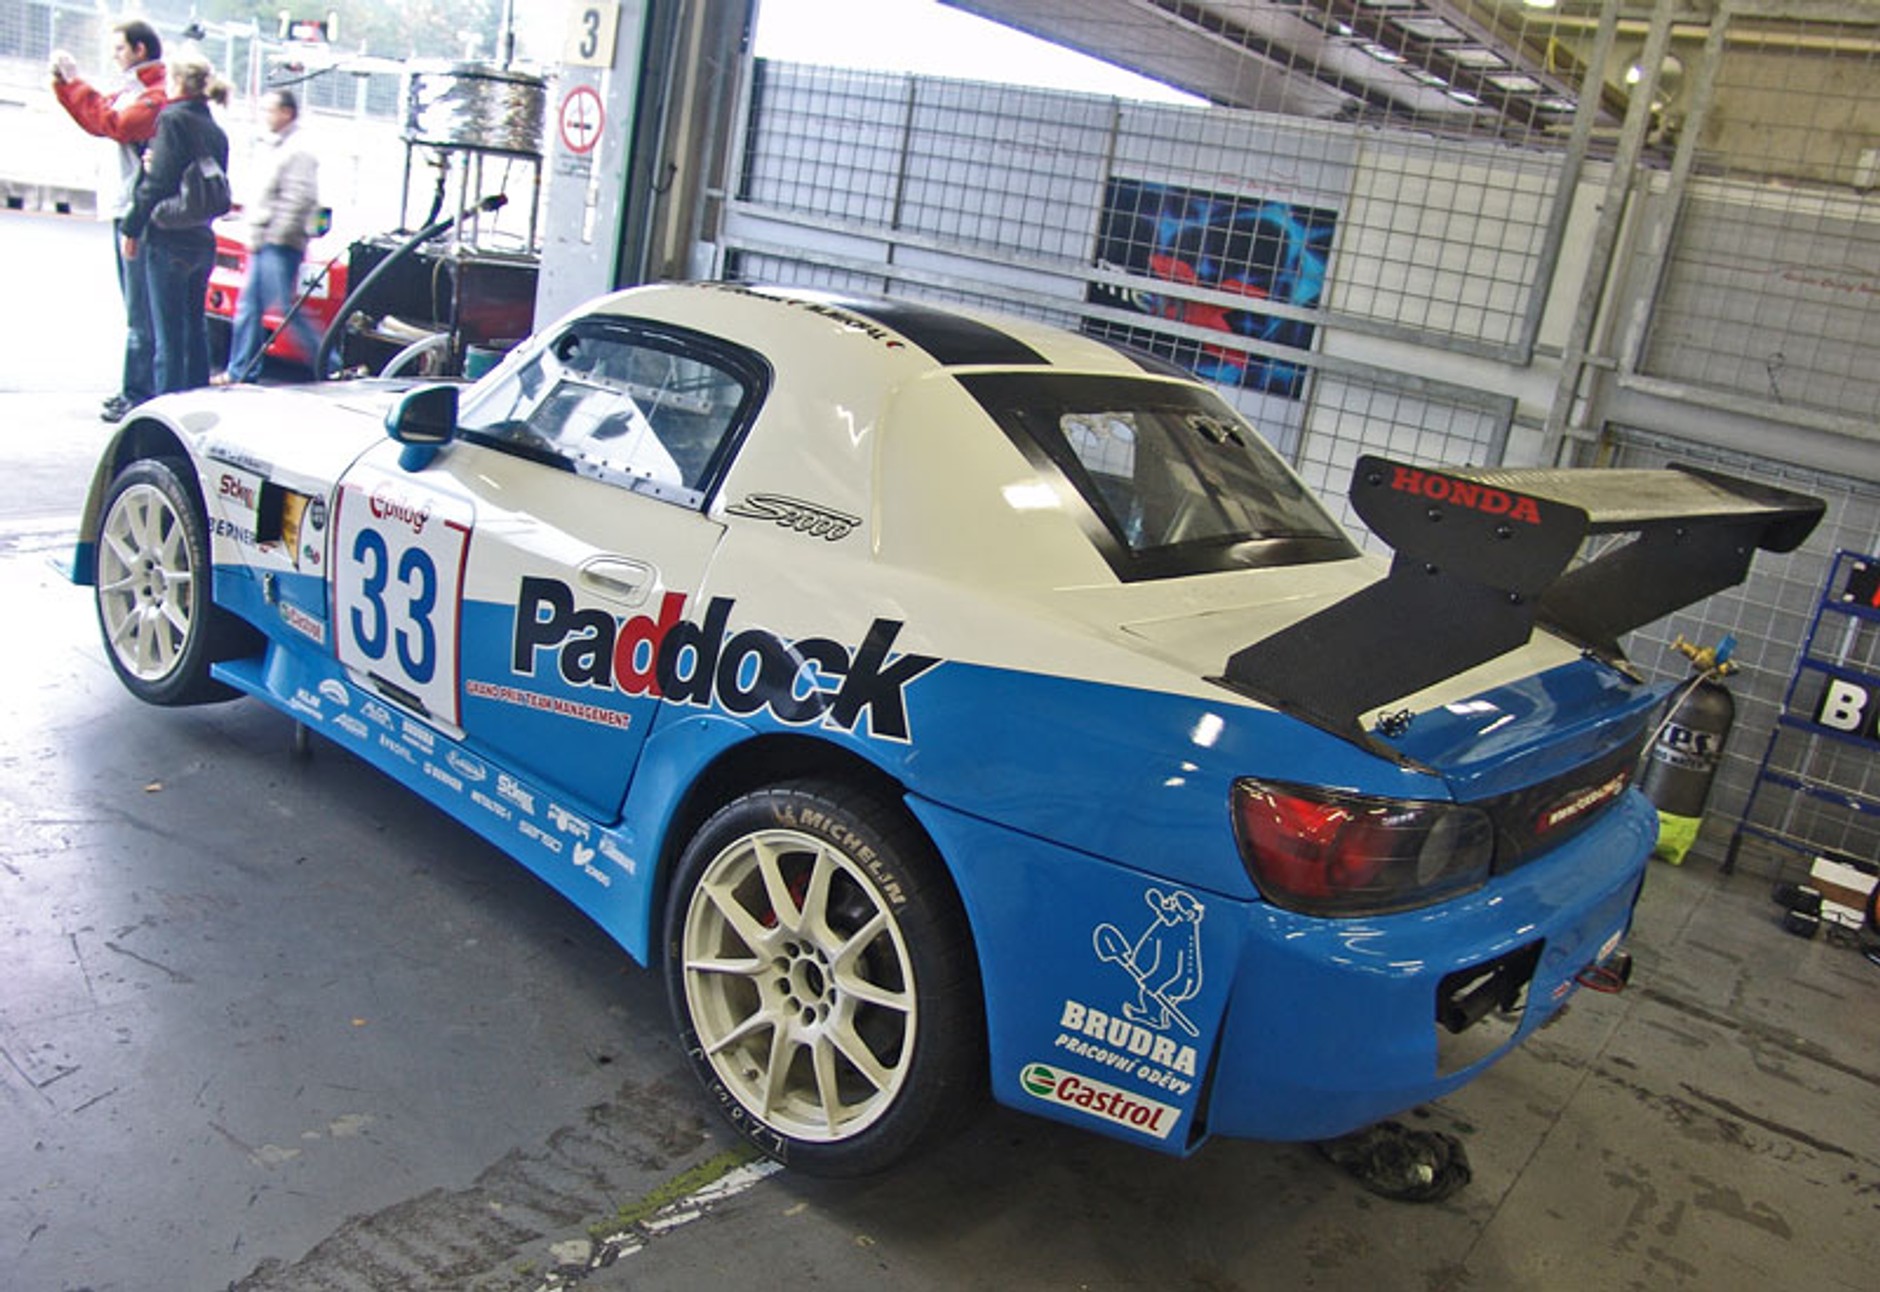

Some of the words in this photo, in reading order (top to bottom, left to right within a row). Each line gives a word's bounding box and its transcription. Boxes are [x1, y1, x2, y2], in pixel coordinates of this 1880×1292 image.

[580, 9, 601, 60] 3
[724, 492, 863, 542] S2000
[1391, 466, 1543, 524] HONDA
[350, 528, 438, 684] 33
[513, 576, 944, 743] Paddock
[466, 680, 499, 700] GRAND
[501, 687, 524, 705] PRIX
[526, 692, 552, 712] TEAM
[553, 698, 631, 730] MANAGEMENT
[800, 808, 906, 904] MICHELIN
[1055, 1033, 1139, 1073] PRACOVNÍ
[1060, 999, 1197, 1077] BRUDRA
[1056, 1076, 1165, 1131] Castrol
